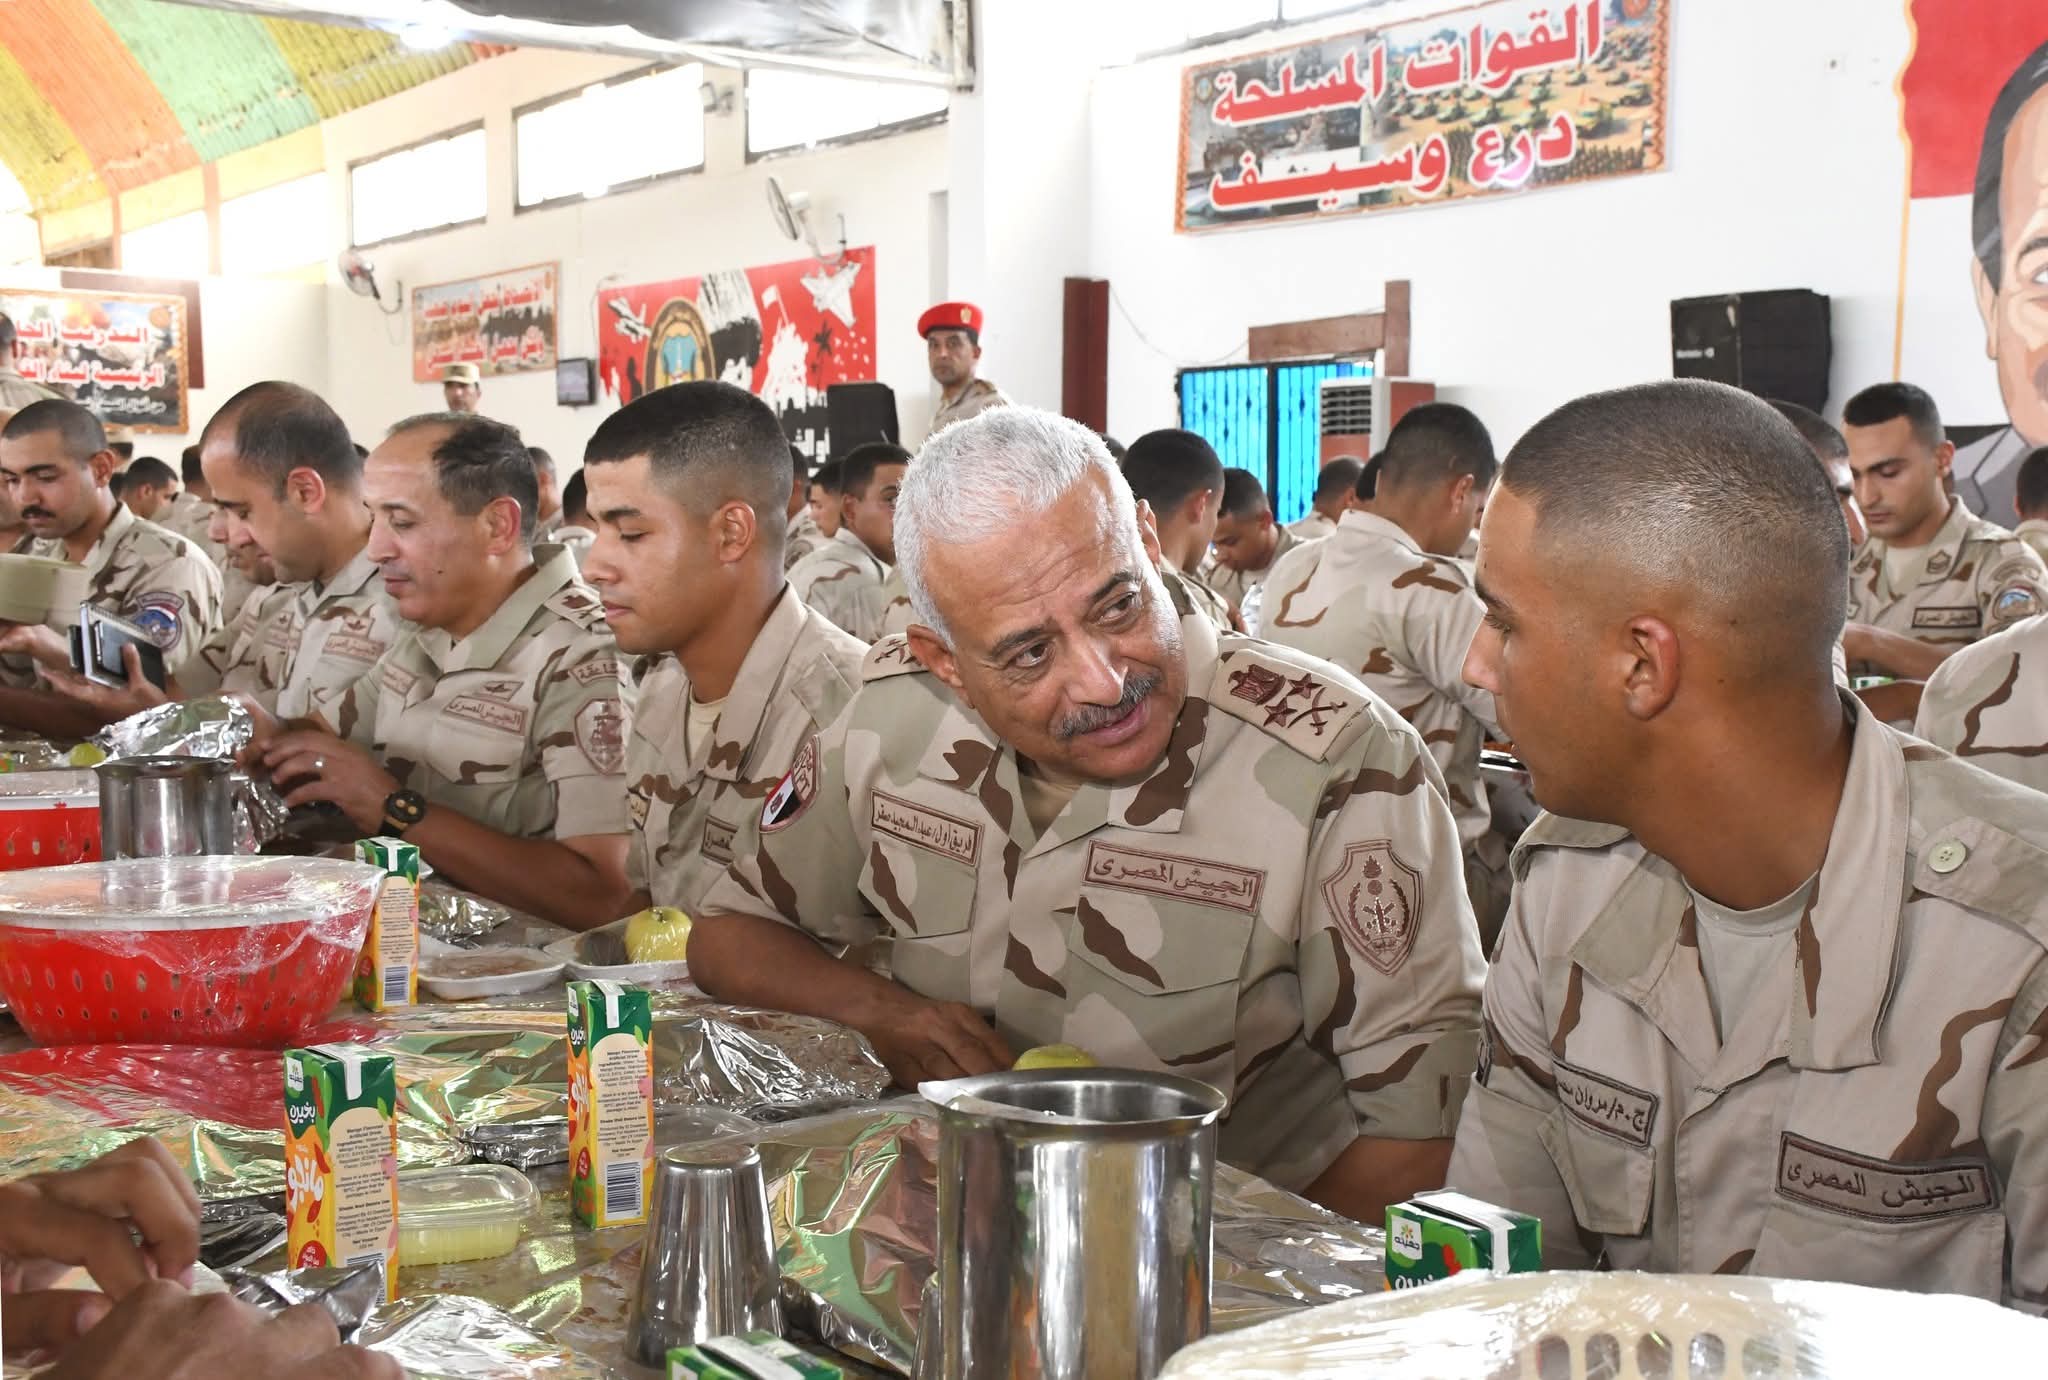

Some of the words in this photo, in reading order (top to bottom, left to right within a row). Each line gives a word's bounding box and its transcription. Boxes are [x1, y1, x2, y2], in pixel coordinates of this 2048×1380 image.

[1406, 0, 1604, 89] القوات
[1212, 47, 1386, 124] المسلحة
[1209, 136, 1448, 209] وسيف
[1470, 113, 1575, 184] درع
[1174, 868, 1253, 898] الجيش
[1881, 1175, 1975, 1208] الجيش
